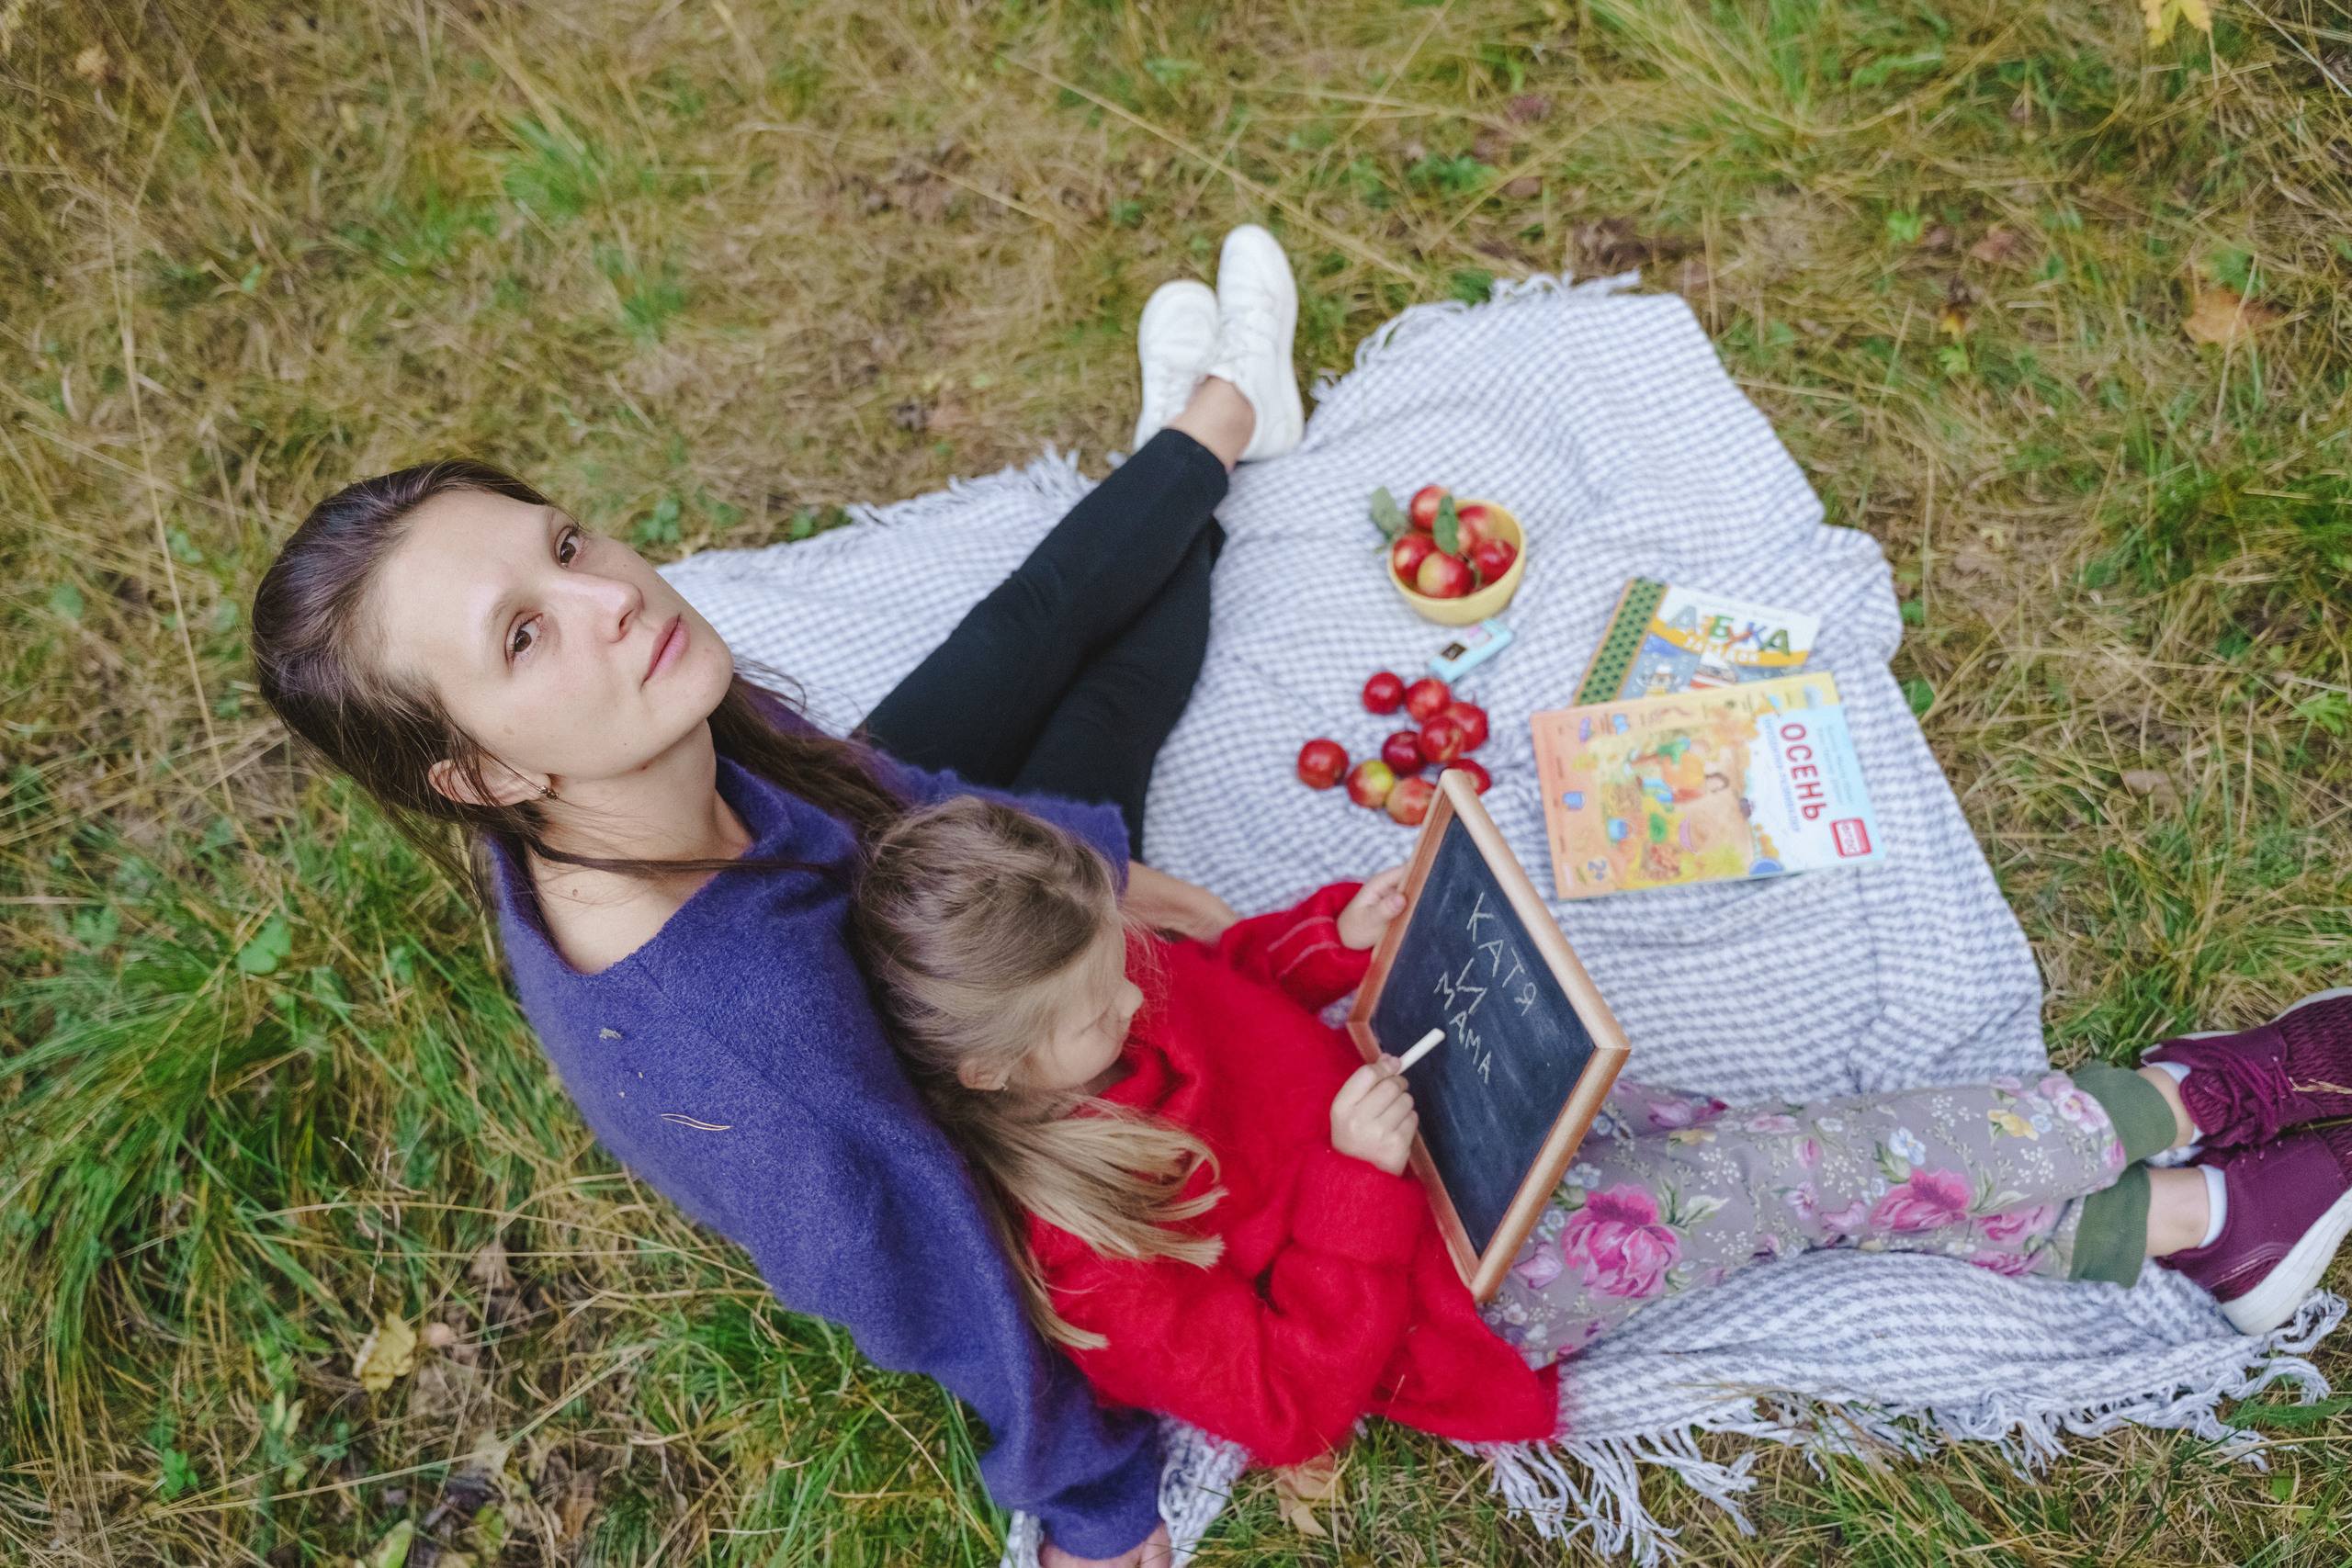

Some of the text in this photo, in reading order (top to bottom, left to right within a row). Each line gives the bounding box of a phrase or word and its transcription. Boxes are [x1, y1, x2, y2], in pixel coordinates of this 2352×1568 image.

[1665, 604, 1792, 658] АЗБУКА
[1781, 723, 1827, 821] ОСЕНЬ
[1466, 891, 1537, 1017] КАТЯ
[1433, 970, 1492, 1085] МАМА
